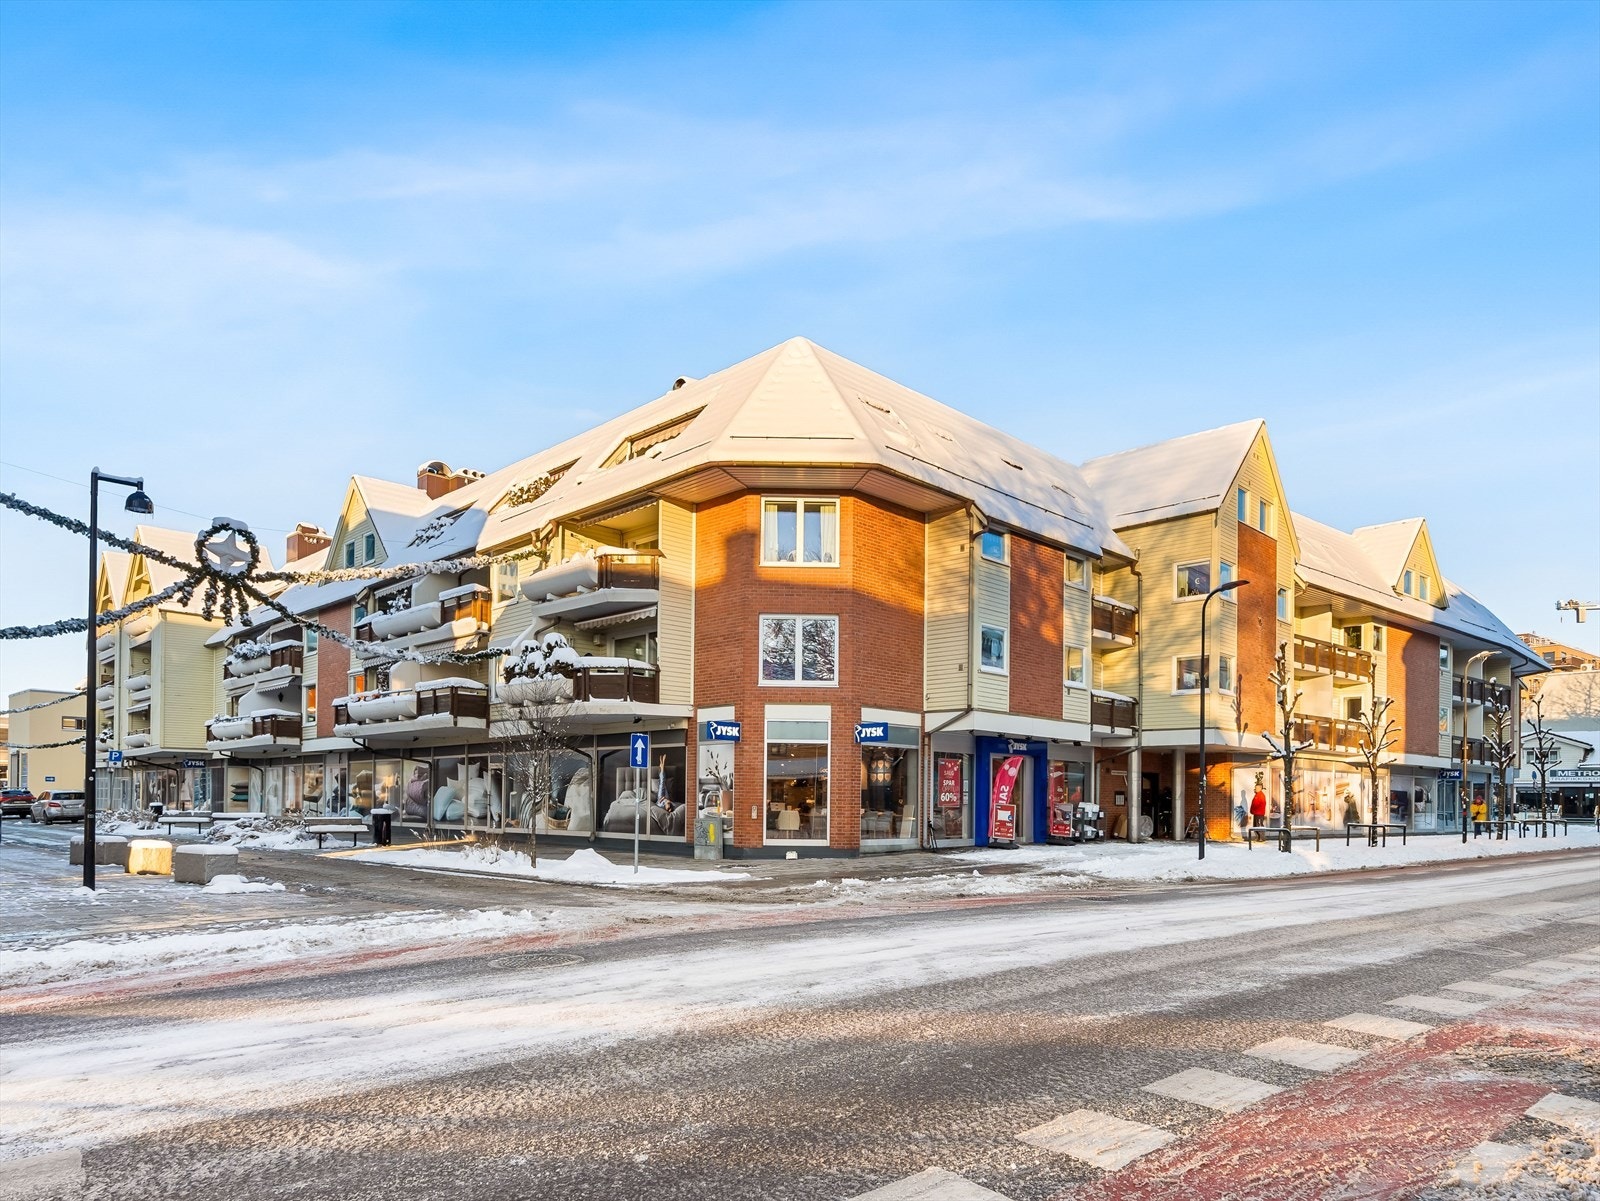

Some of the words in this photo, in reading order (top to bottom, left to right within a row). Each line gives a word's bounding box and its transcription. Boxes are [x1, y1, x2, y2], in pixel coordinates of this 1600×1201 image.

[715, 725, 739, 737] JYSK
[860, 726, 884, 738] JYSK
[1013, 742, 1028, 751] JYSK
[112, 752, 120, 760] P
[1442, 770, 1460, 778] JYSK
[940, 792, 957, 802] 60%
